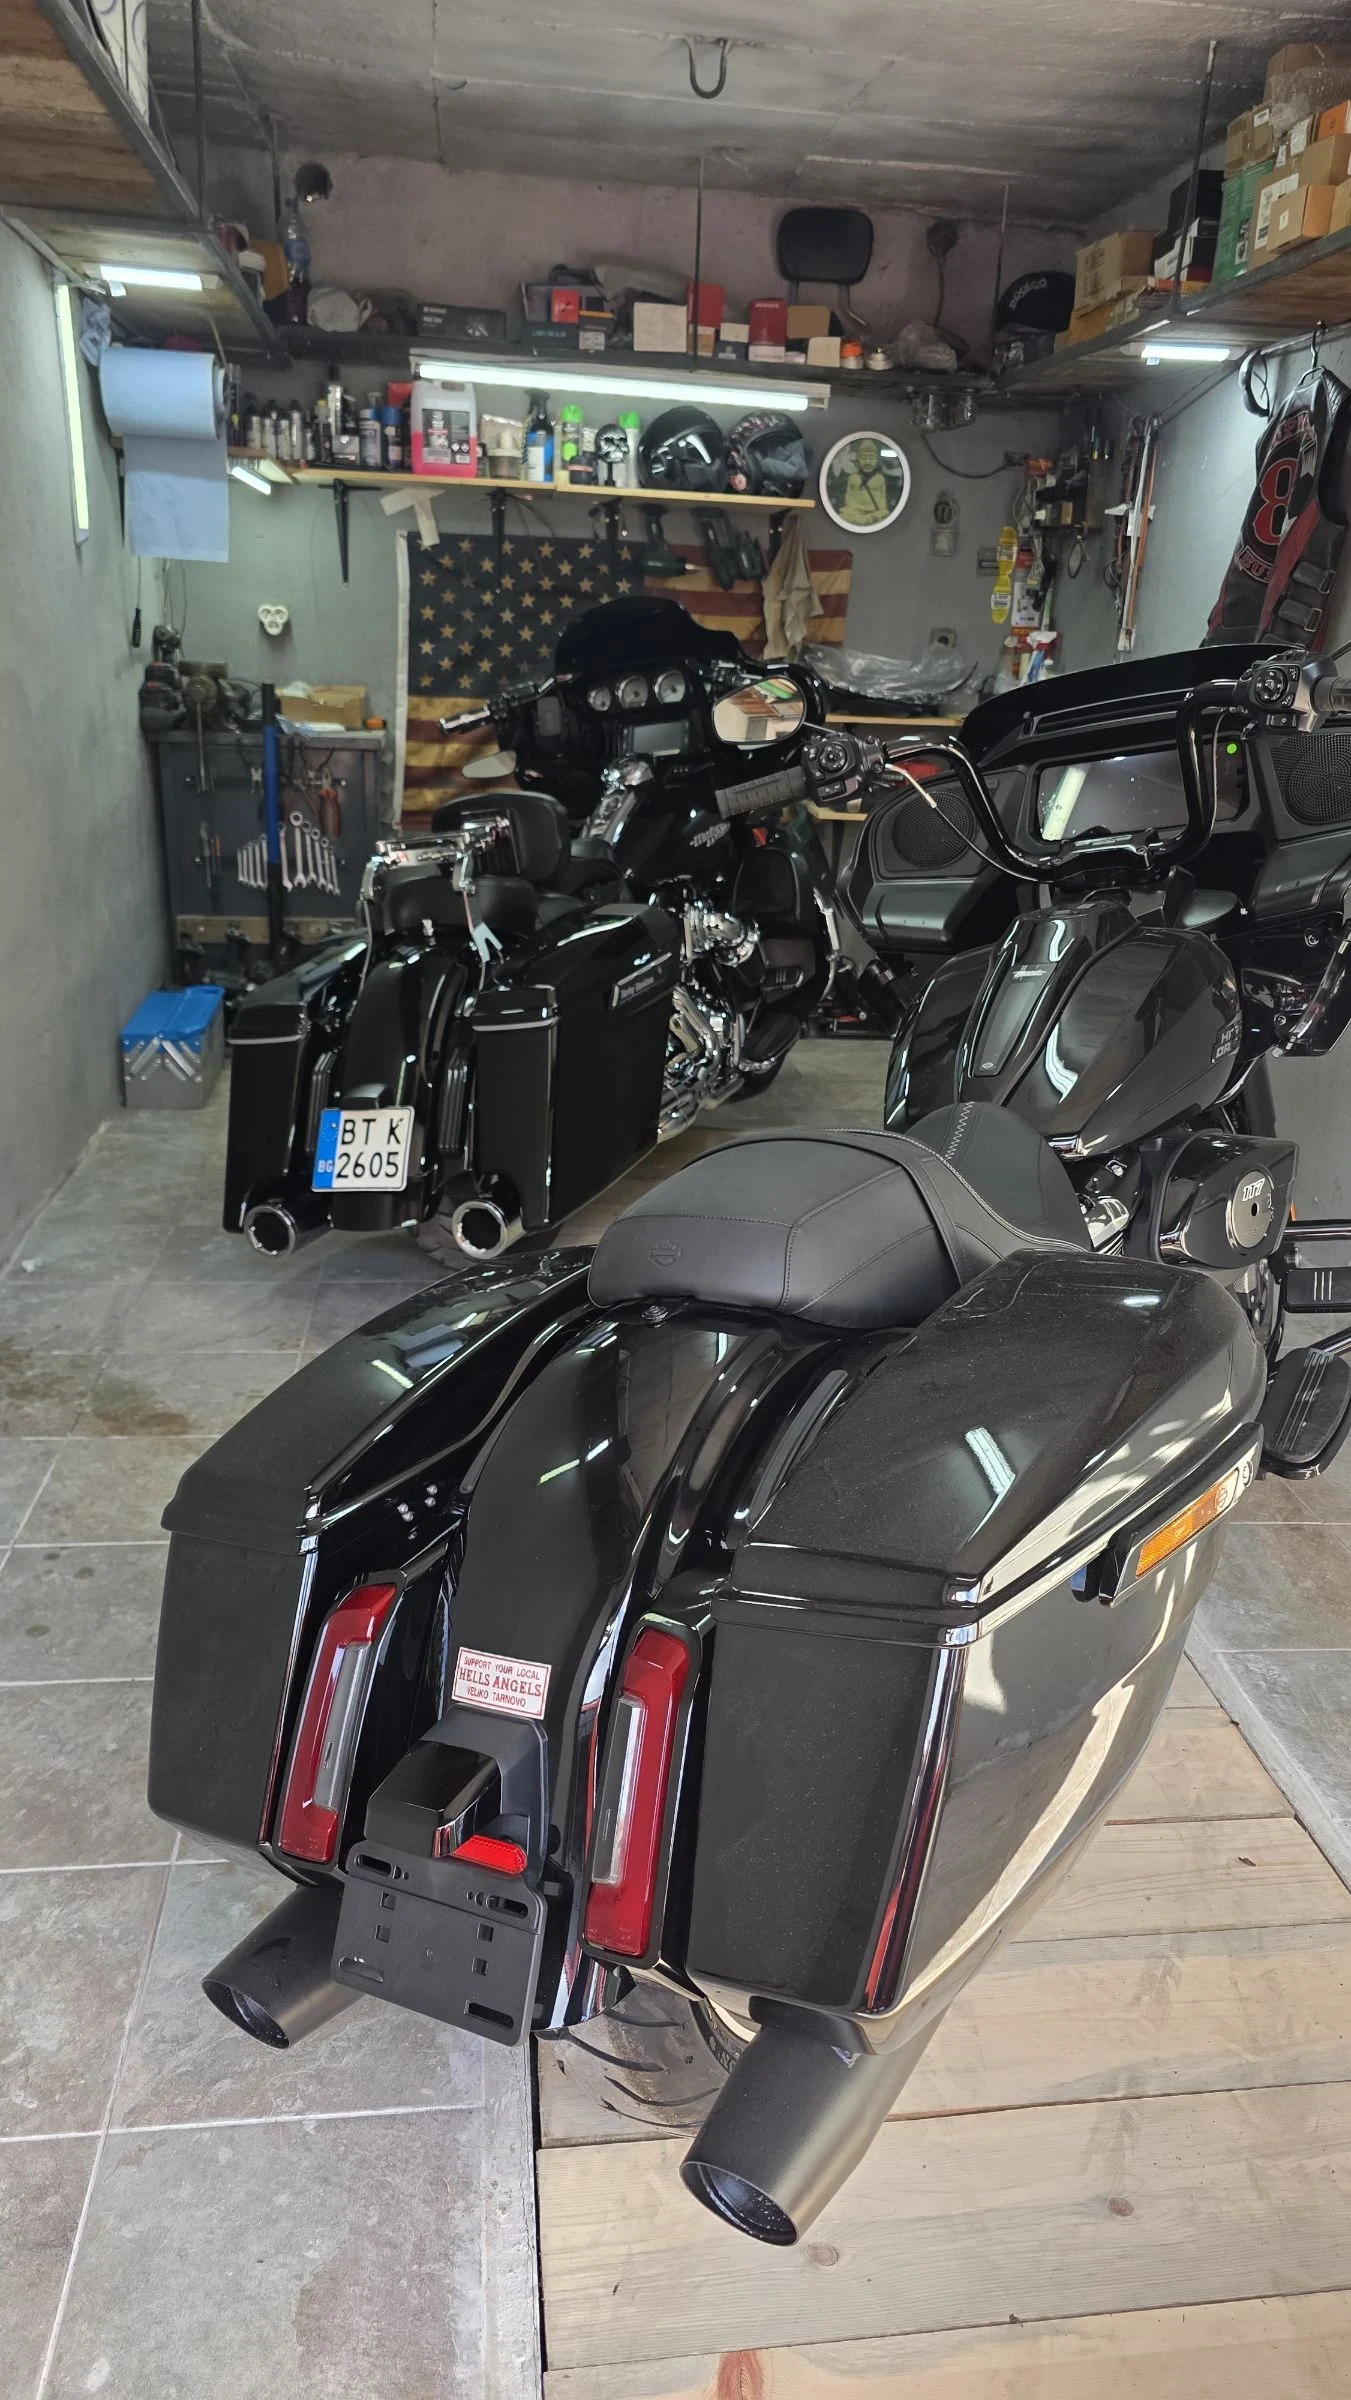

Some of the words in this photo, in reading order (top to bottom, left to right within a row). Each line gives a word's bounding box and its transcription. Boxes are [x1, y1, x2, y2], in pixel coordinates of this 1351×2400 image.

[317, 1159, 333, 1174] BG
[336, 1152, 399, 1179] 2605
[1242, 1177, 1266, 1202] 117
[464, 1656, 491, 1670] SUPPORT
[495, 1663, 513, 1675] YOUR
[517, 1669, 540, 1680] LOCAL
[459, 1667, 490, 1686] HELLS
[492, 1676, 541, 1696] ANGELS
[467, 1686, 489, 1699] VELIKO
[493, 1692, 526, 1707] TARNOVO
